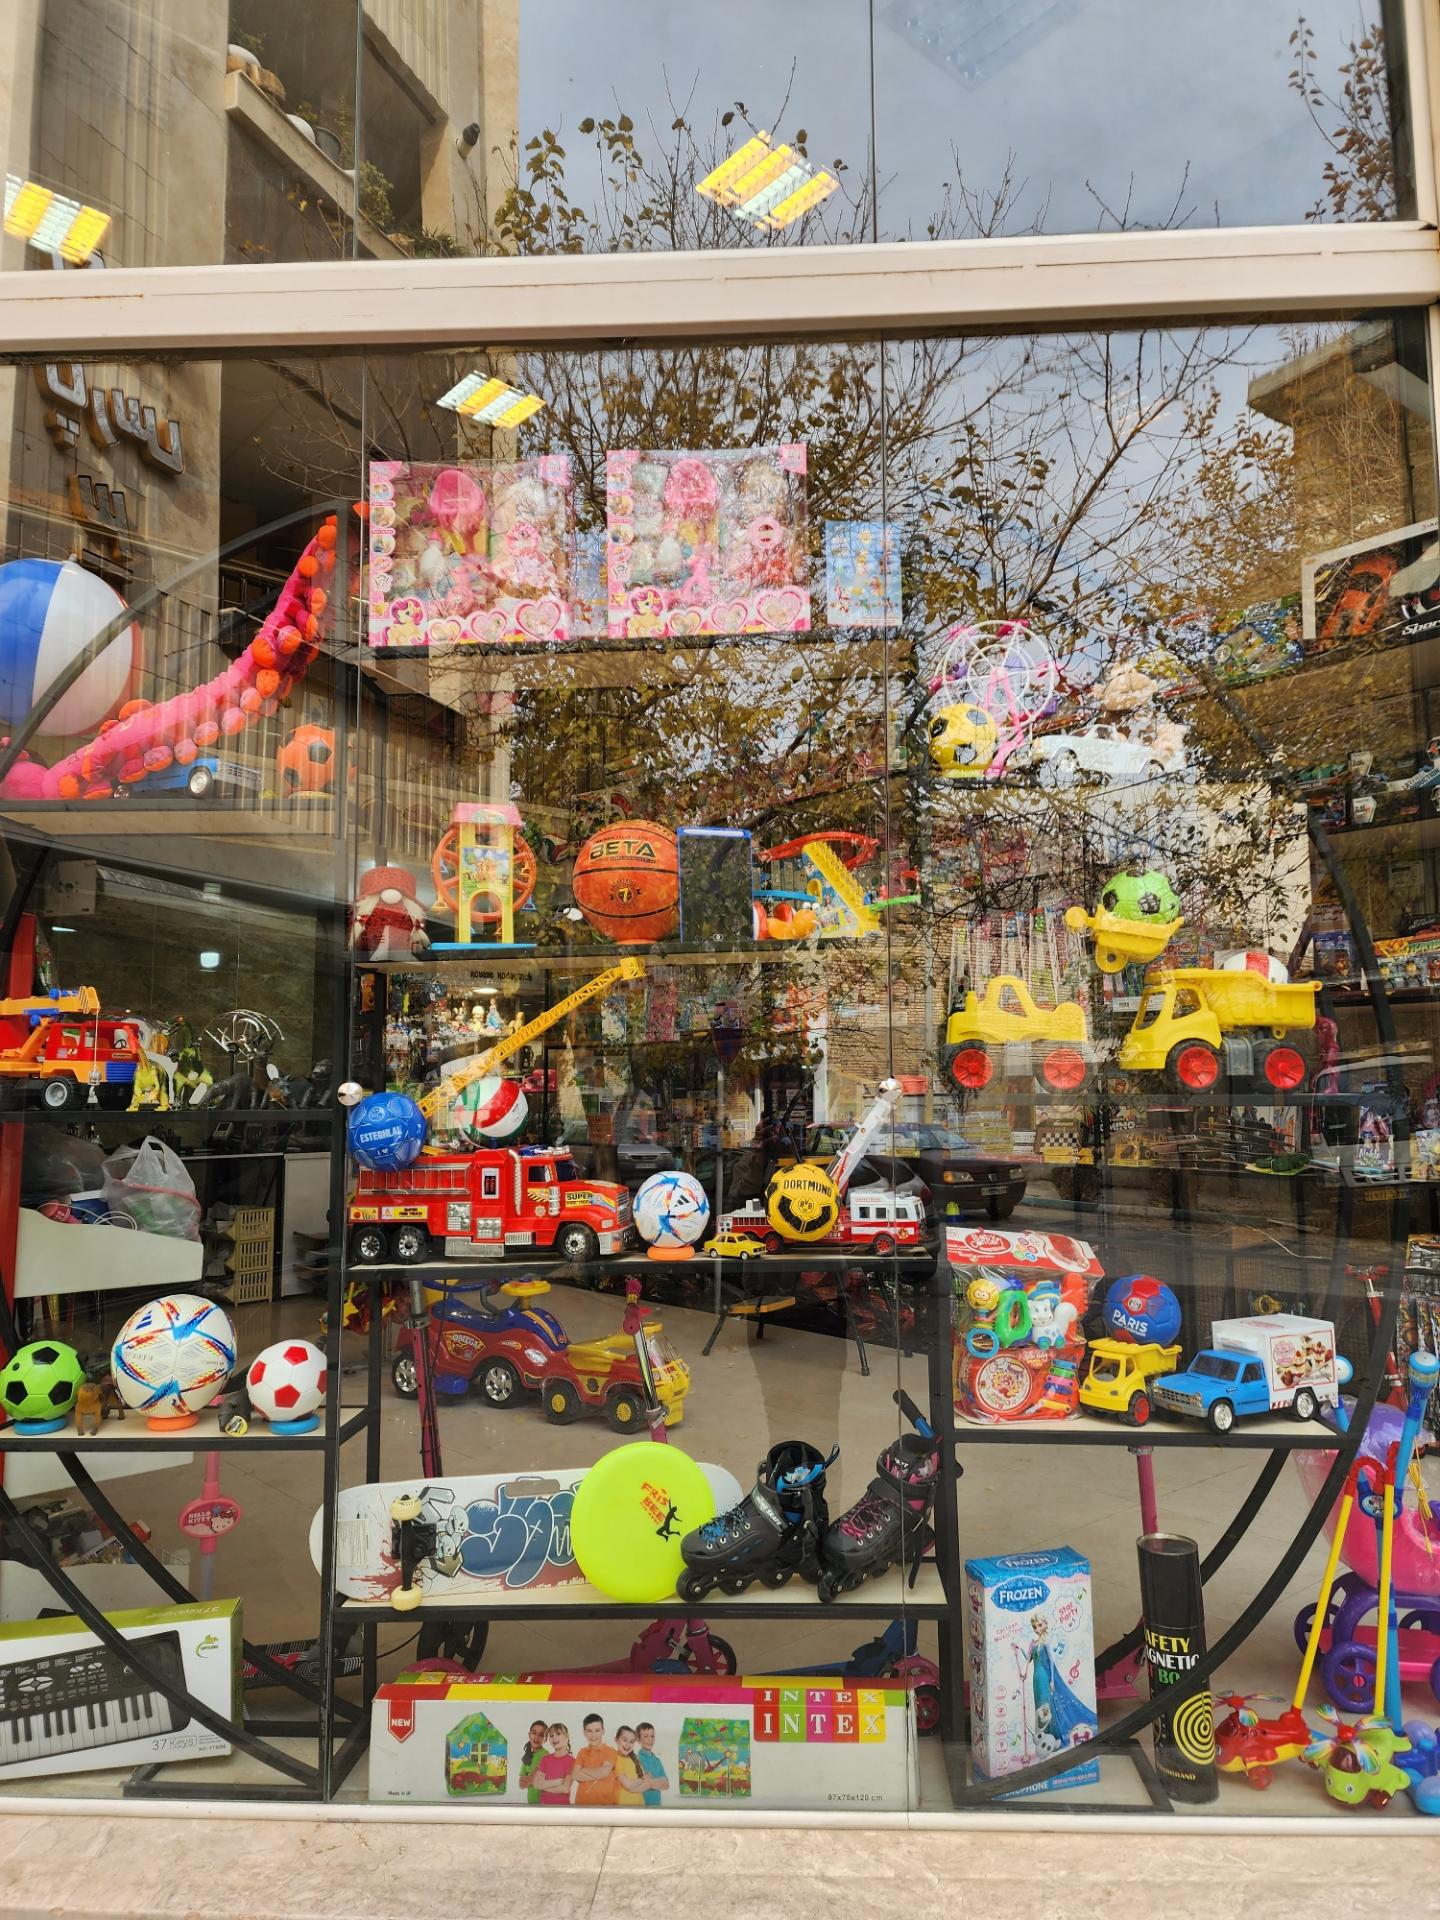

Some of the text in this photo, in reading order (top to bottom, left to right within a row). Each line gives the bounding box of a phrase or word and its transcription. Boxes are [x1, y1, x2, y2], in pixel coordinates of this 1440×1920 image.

[589, 839, 656, 862] BETA
[360, 1125, 402, 1143] ESTEGHLAL
[566, 1192, 593, 1200] SUPER
[783, 1180, 832, 1197] DORTMUND
[1113, 1309, 1149, 1333] PARIS
[1004, 1556, 1051, 1568] FROZEN
[999, 1586, 1043, 1604] FROZEN
[1145, 1629, 1190, 1653] AFETY
[1158, 1668, 1181, 1685] BO
[763, 1690, 880, 1703] INTEX
[391, 1718, 411, 1727] NEW
[763, 1713, 881, 1735] INTEX
[152, 1738, 168, 1751] 37
[169, 1736, 195, 1749] Keys
